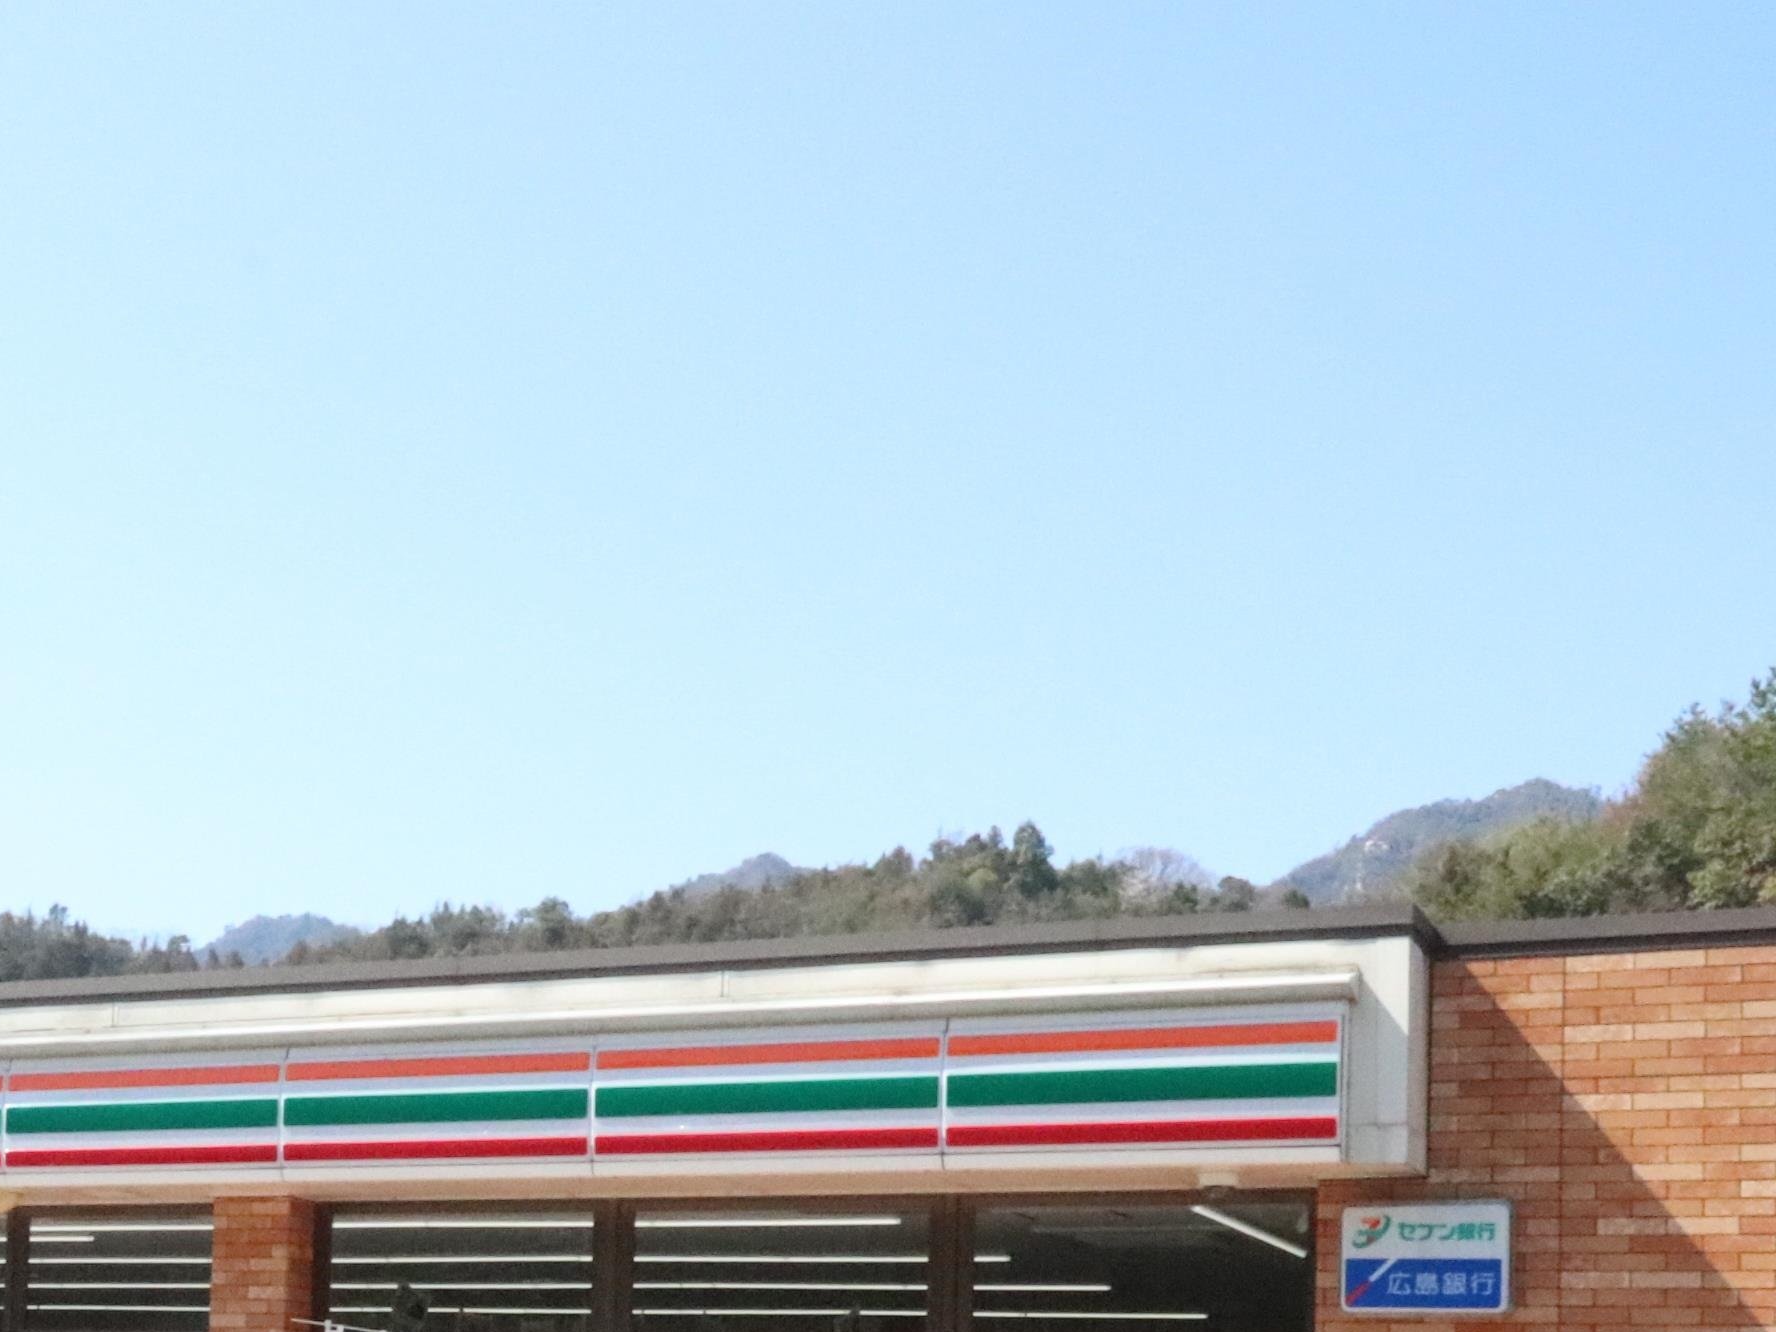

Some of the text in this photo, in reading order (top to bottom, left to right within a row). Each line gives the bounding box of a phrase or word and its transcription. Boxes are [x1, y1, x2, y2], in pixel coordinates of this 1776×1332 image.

[1397, 1221, 1496, 1242] セブン銀行
[1387, 1271, 1496, 1296] 広島銀行
